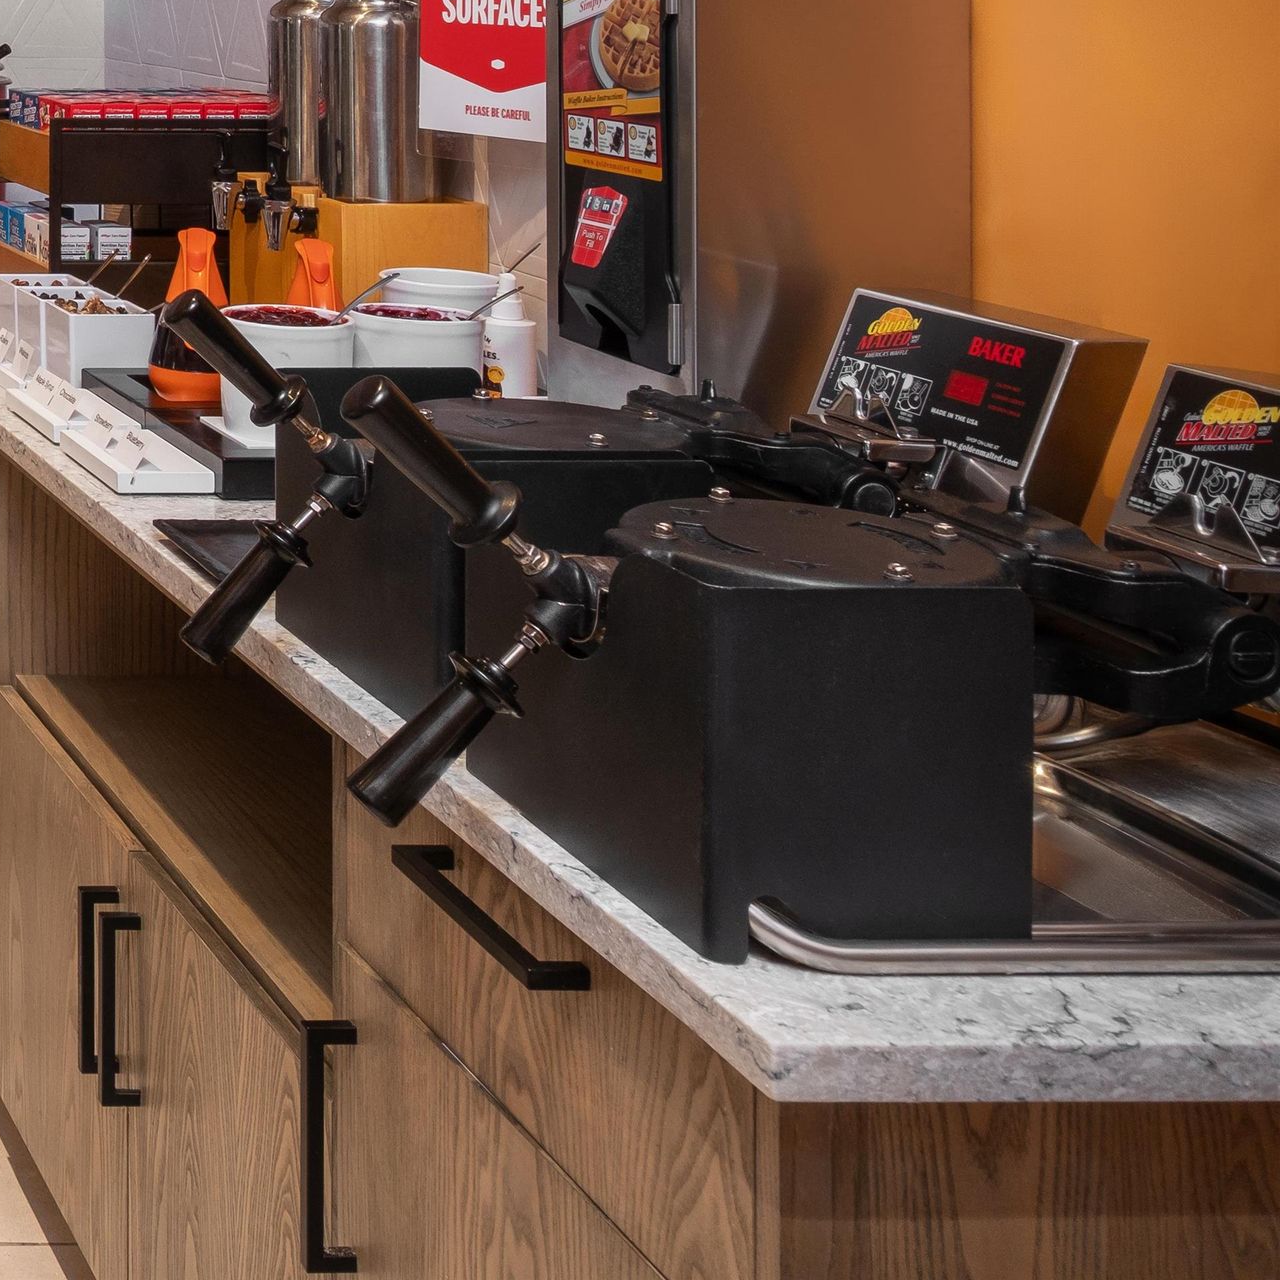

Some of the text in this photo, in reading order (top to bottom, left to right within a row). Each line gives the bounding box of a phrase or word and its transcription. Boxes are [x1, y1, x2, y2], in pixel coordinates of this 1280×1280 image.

[465, 104, 531, 122] PLEASE BE CAREFUL
[582, 229, 604, 241] Push To
[867, 317, 923, 336] GOLDEN
[856, 331, 913, 351] MALTED
[967, 335, 1027, 369] BAKER
[930, 406, 947, 418] MADE
[954, 413, 968, 423] THE
[966, 417, 979, 427] USA
[1201, 405, 1280, 426] GOLDEN
[1175, 421, 1258, 442] MALTED
[942, 438, 1020, 468] www.goldenmalted.com
[1191, 443, 1255, 452] AMERICA'S WAFFLE
